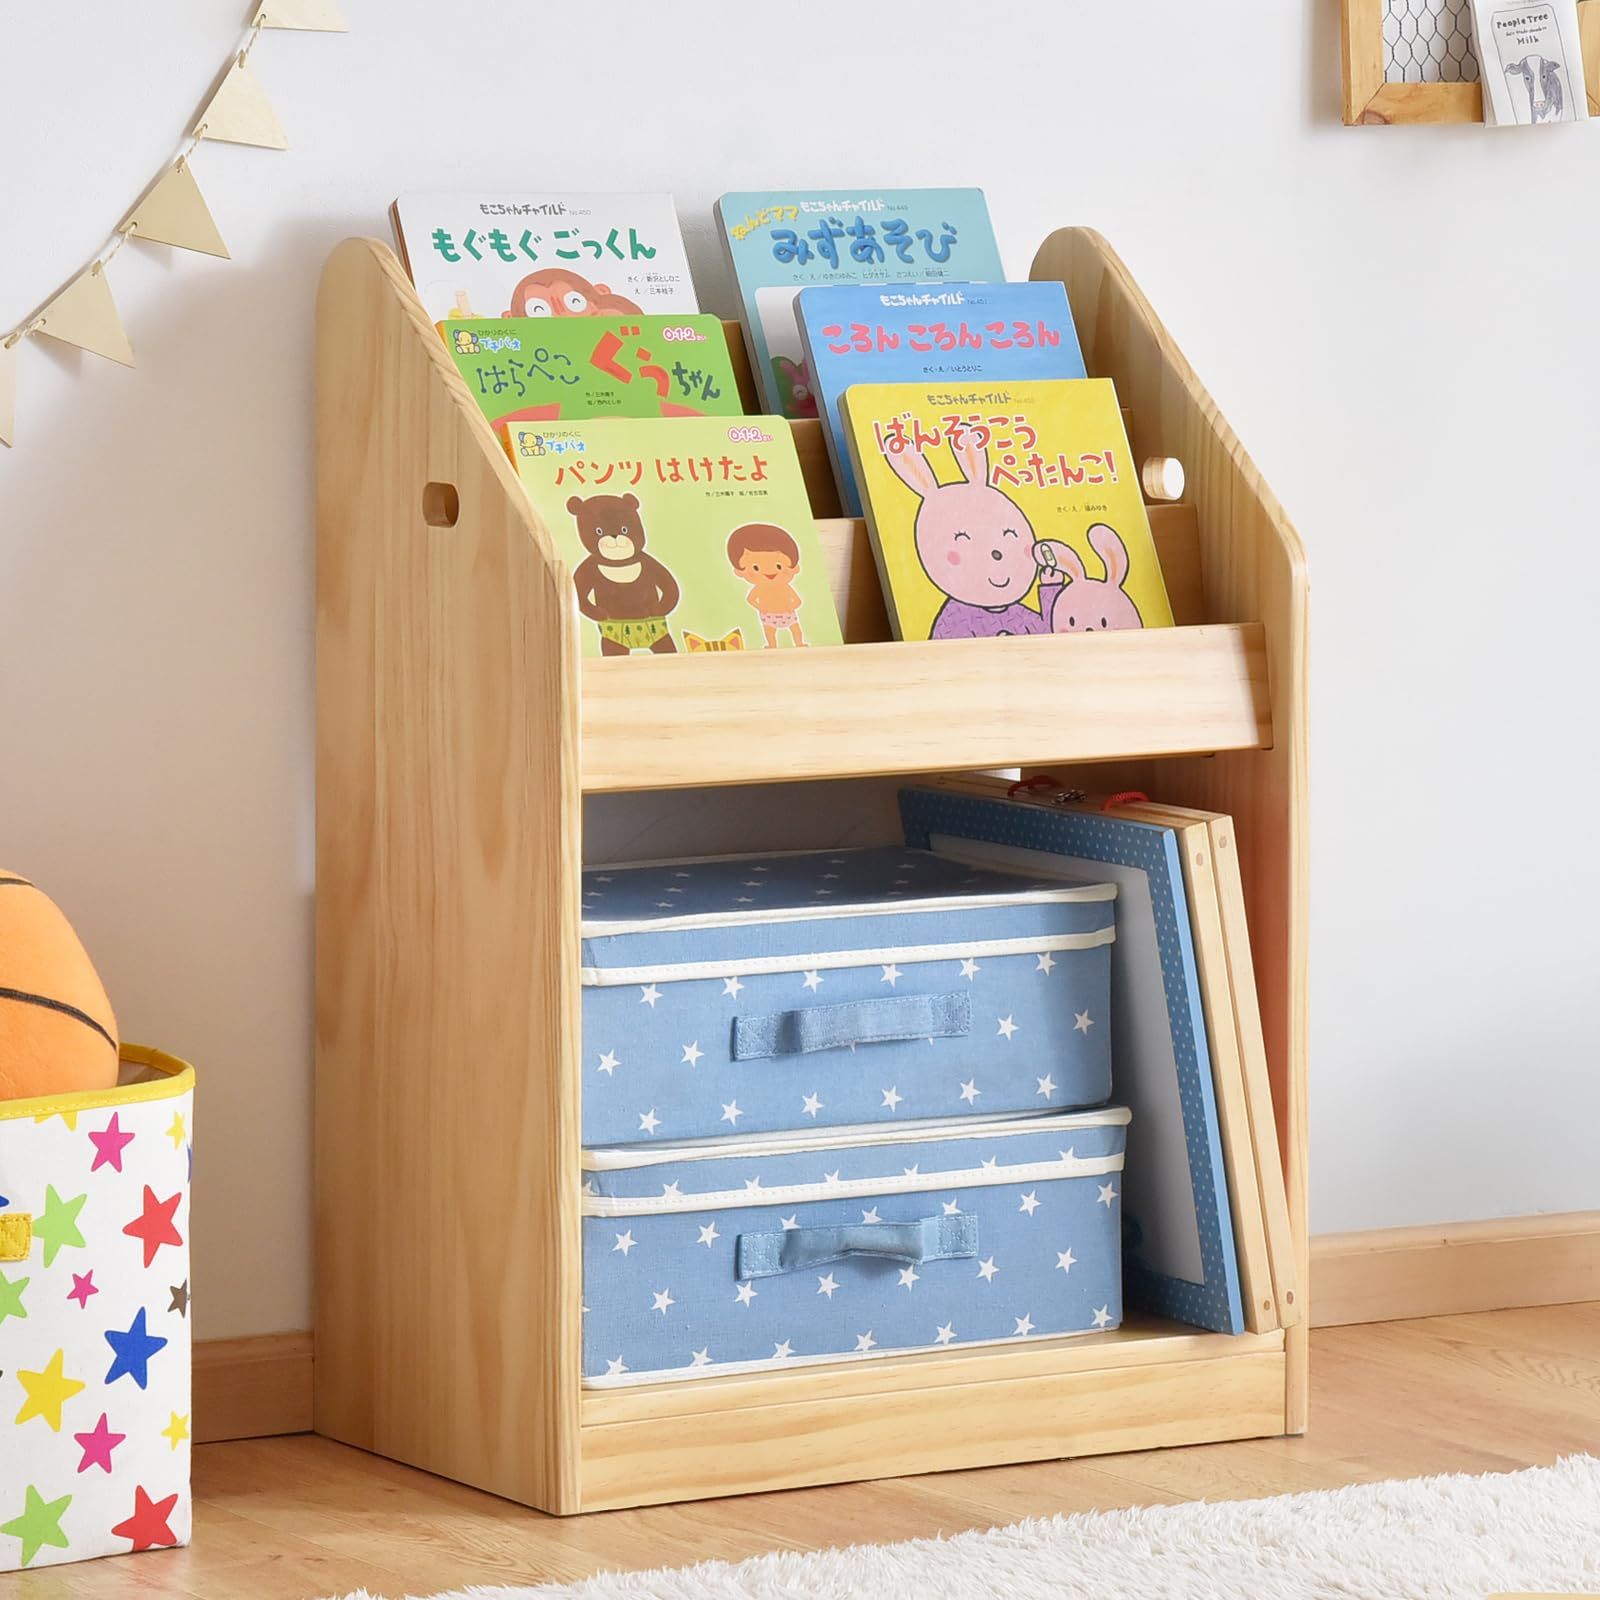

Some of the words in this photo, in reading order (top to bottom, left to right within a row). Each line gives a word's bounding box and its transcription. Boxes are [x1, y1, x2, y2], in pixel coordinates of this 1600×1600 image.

[1496, 17, 1526, 29] People
[1526, 13, 1549, 24] Tree
[1516, 35, 1540, 46] Milk
[479, 201, 566, 216] もこちゃんチャイルド
[800, 199, 885, 213] もこちゃんチャイルド
[730, 205, 799, 240] ねんどママ
[432, 227, 542, 263] もぐもぐ
[554, 226, 657, 261] ごっくん
[770, 215, 958, 269] みずあそび
[879, 291, 965, 306] もこちゃんチャイルド
[822, 323, 901, 354] ころん
[907, 321, 983, 352] ころん
[985, 320, 1061, 350] ころん
[476, 347, 580, 398] はらぺこ
[927, 391, 1012, 406] もこちゃんチャイルド
[543, 431, 581, 439] ひかりのくに
[872, 411, 1037, 455] ばんそうこう
[555, 459, 643, 486] パンツ
[654, 454, 769, 484] はけたよ
